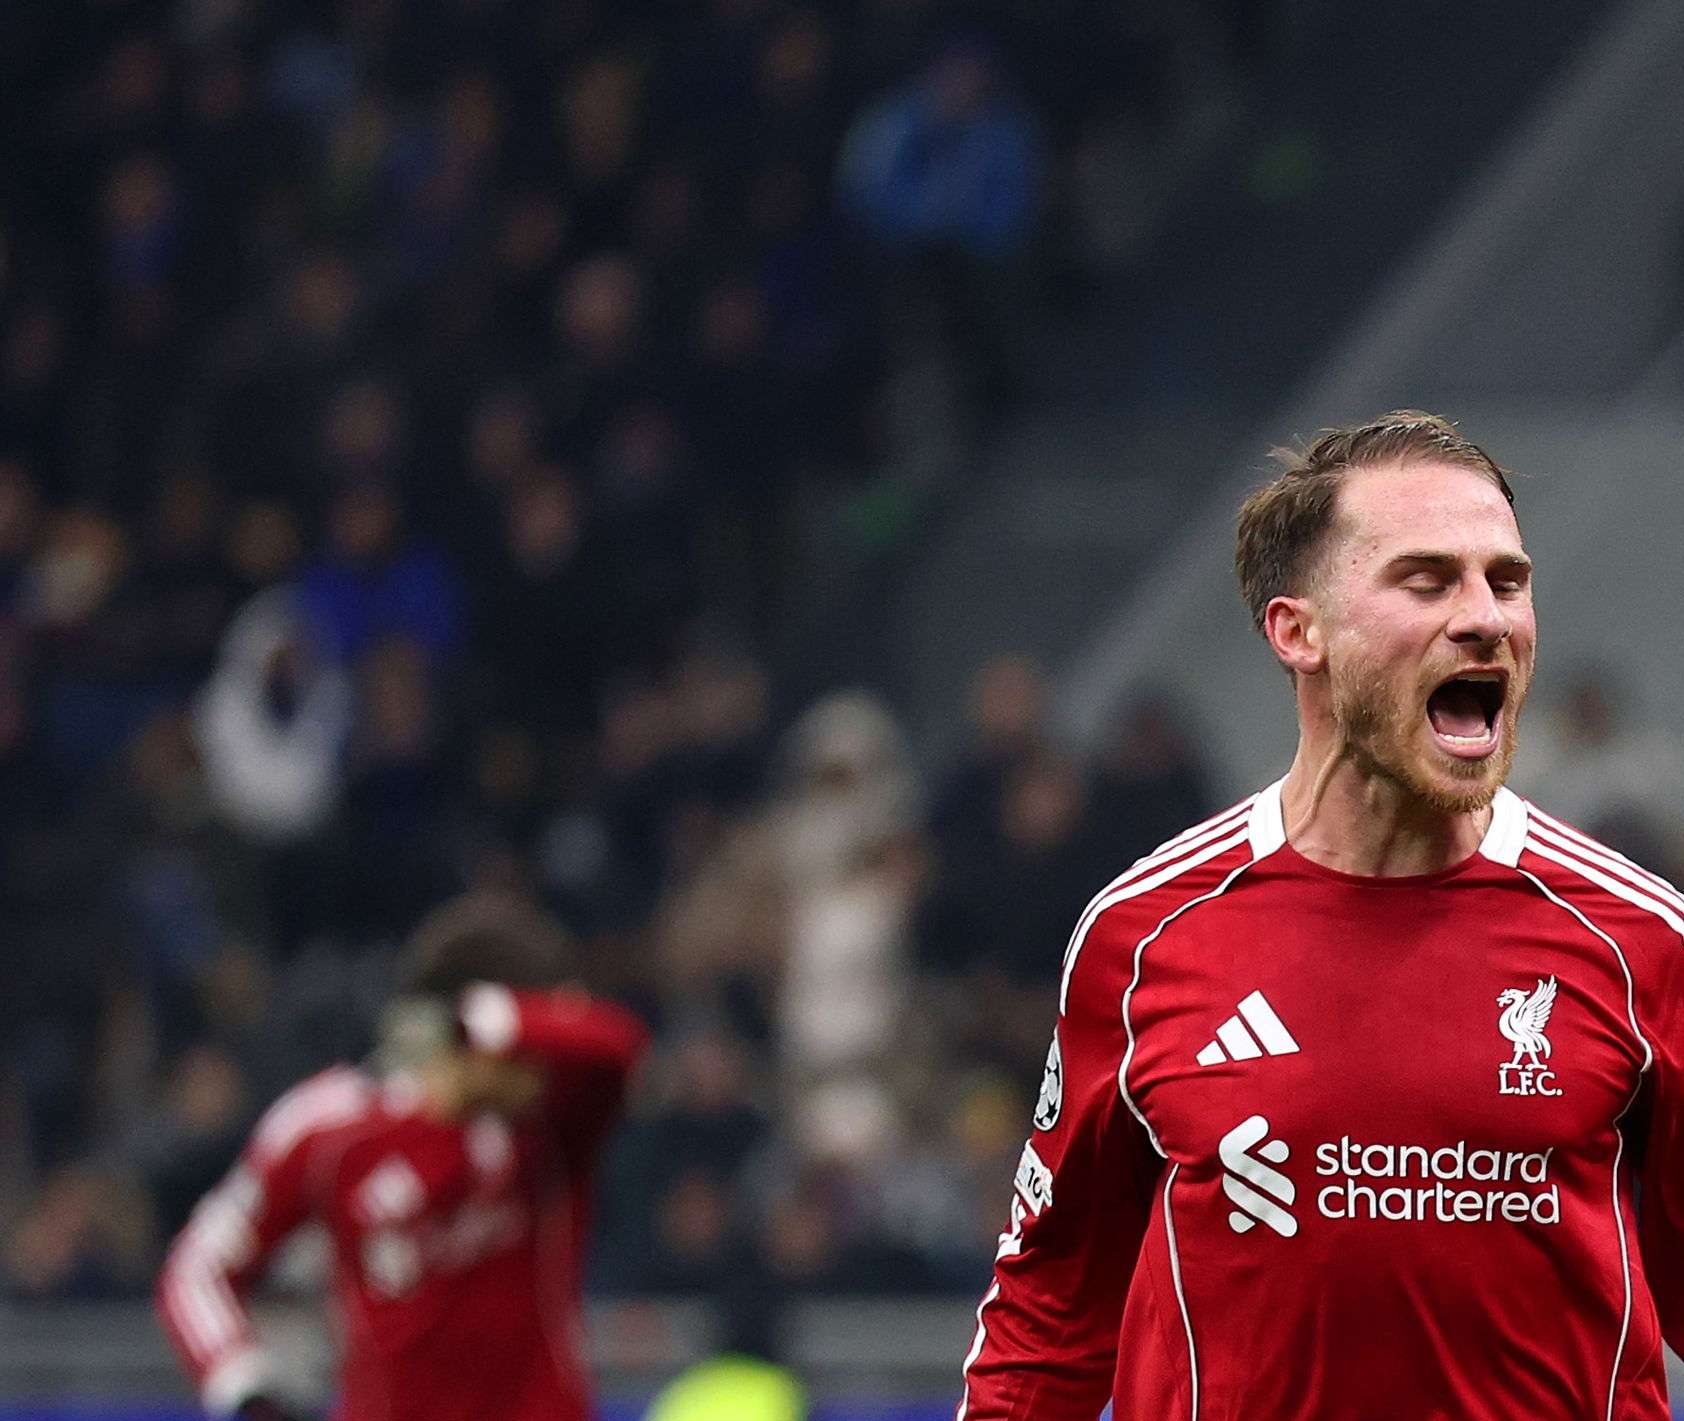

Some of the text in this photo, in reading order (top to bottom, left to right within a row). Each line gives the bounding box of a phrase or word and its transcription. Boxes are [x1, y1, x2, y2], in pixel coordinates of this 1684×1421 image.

[1498, 1069, 1564, 1096] L.F.C.
[1315, 1134, 1554, 1184] standard
[1317, 1178, 1561, 1225] chartered
